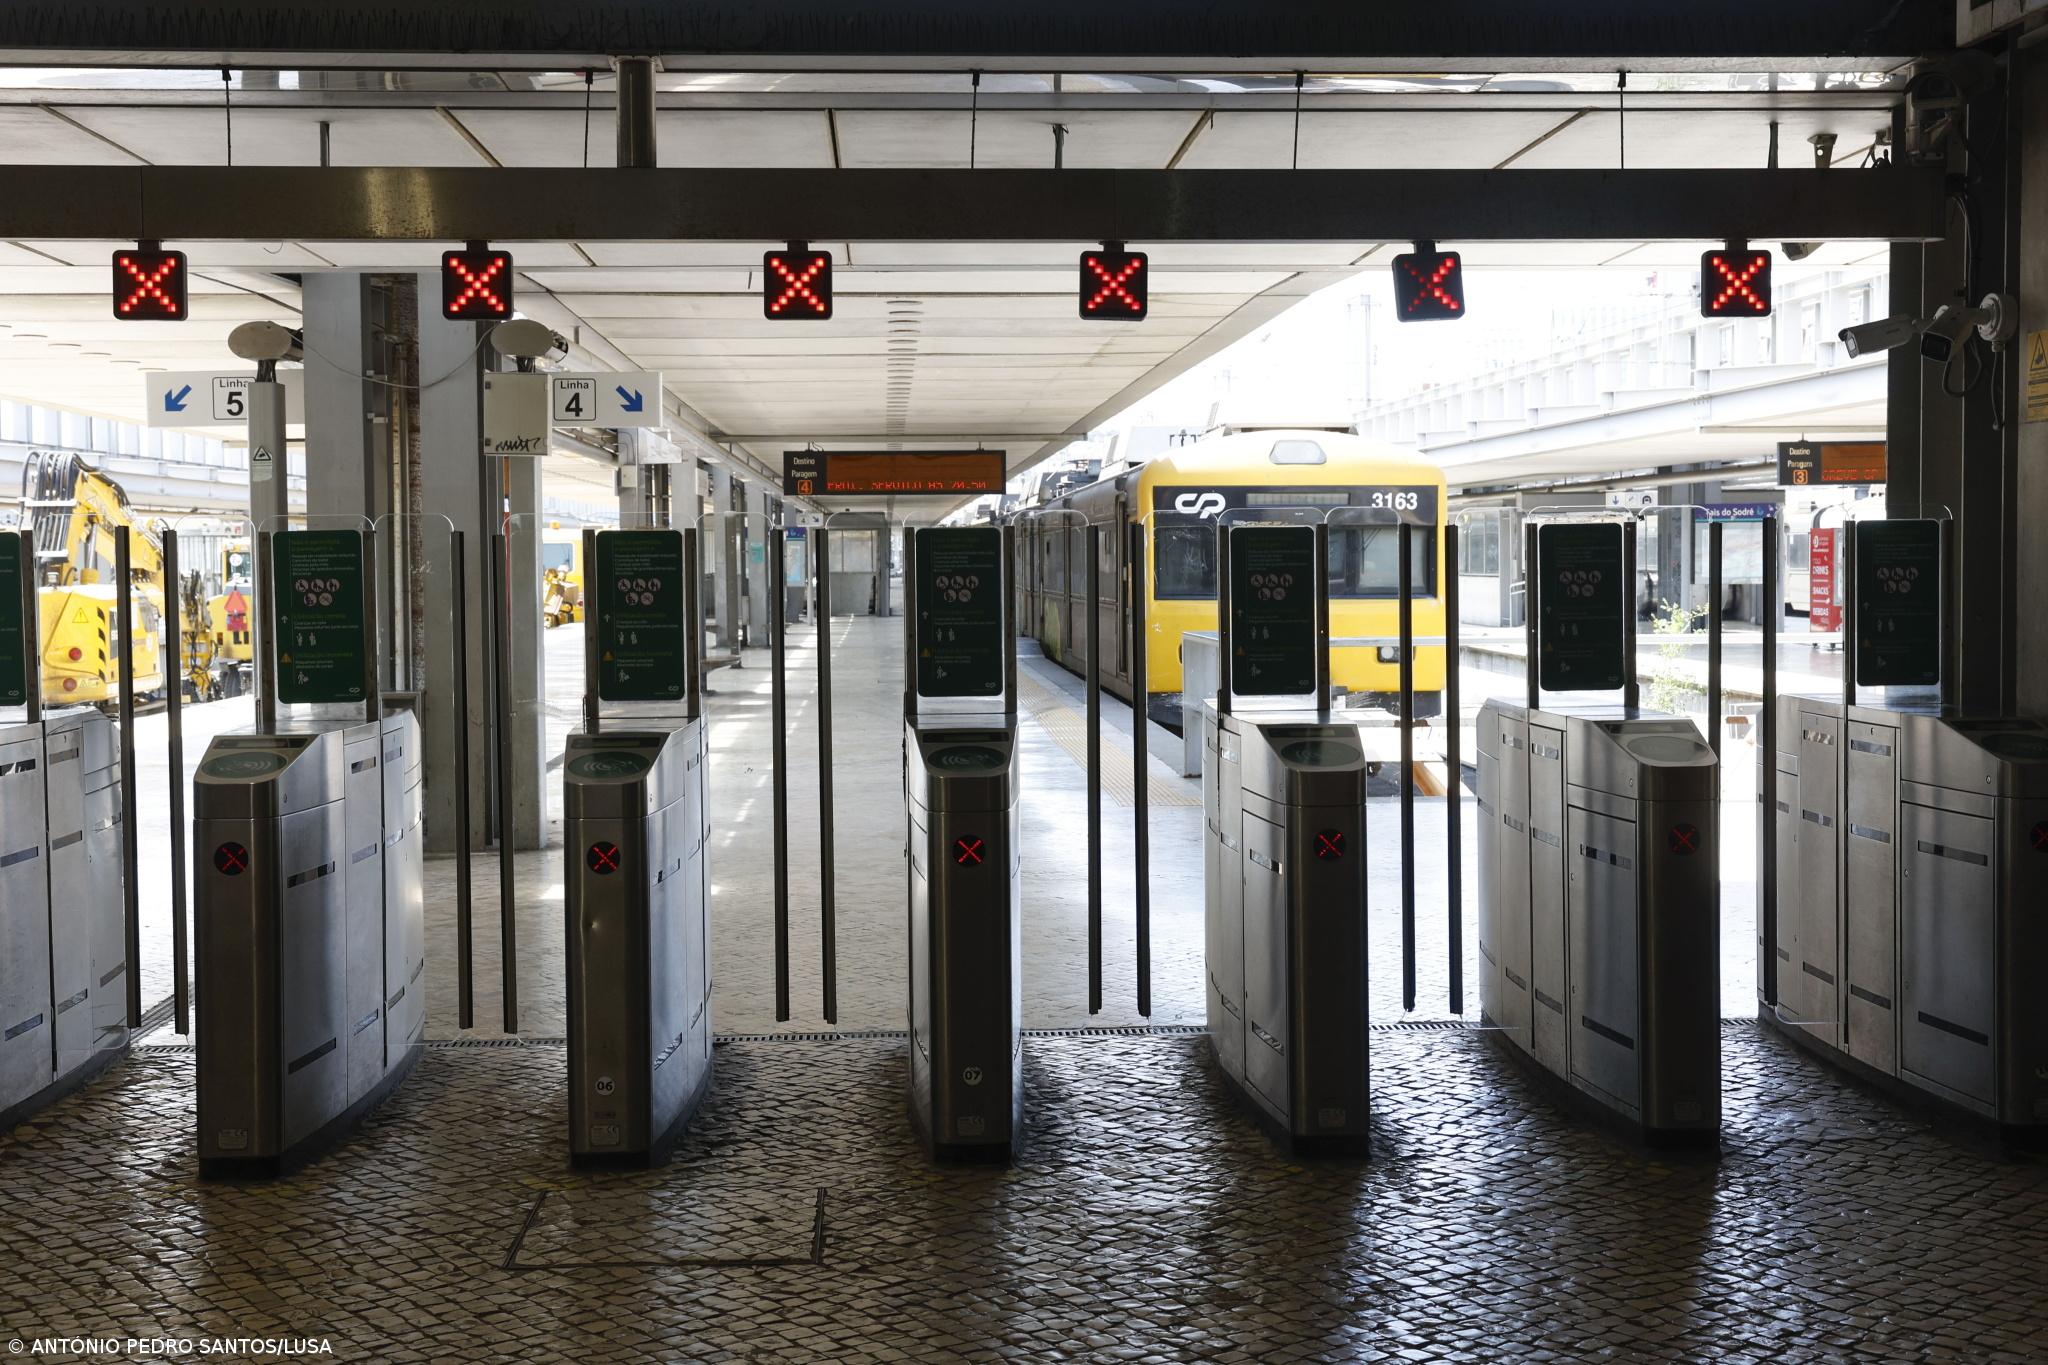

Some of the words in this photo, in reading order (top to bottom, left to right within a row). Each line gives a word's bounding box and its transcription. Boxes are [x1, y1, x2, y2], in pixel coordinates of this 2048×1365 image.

[219, 379, 249, 388] Linha
[560, 381, 589, 390] Linha
[226, 391, 244, 416] 5
[564, 392, 583, 417] 4
[1789, 447, 1810, 456] Destino
[793, 457, 815, 465] Destino
[791, 469, 818, 479] Paragem
[1796, 471, 1805, 483] 3
[800, 480, 809, 493] 4
[1371, 492, 1418, 510] 3163
[1721, 507, 1732, 516] do
[1732, 506, 1754, 516] Sodré
[965, 1071, 981, 1081] 07
[597, 1080, 613, 1091] 06
